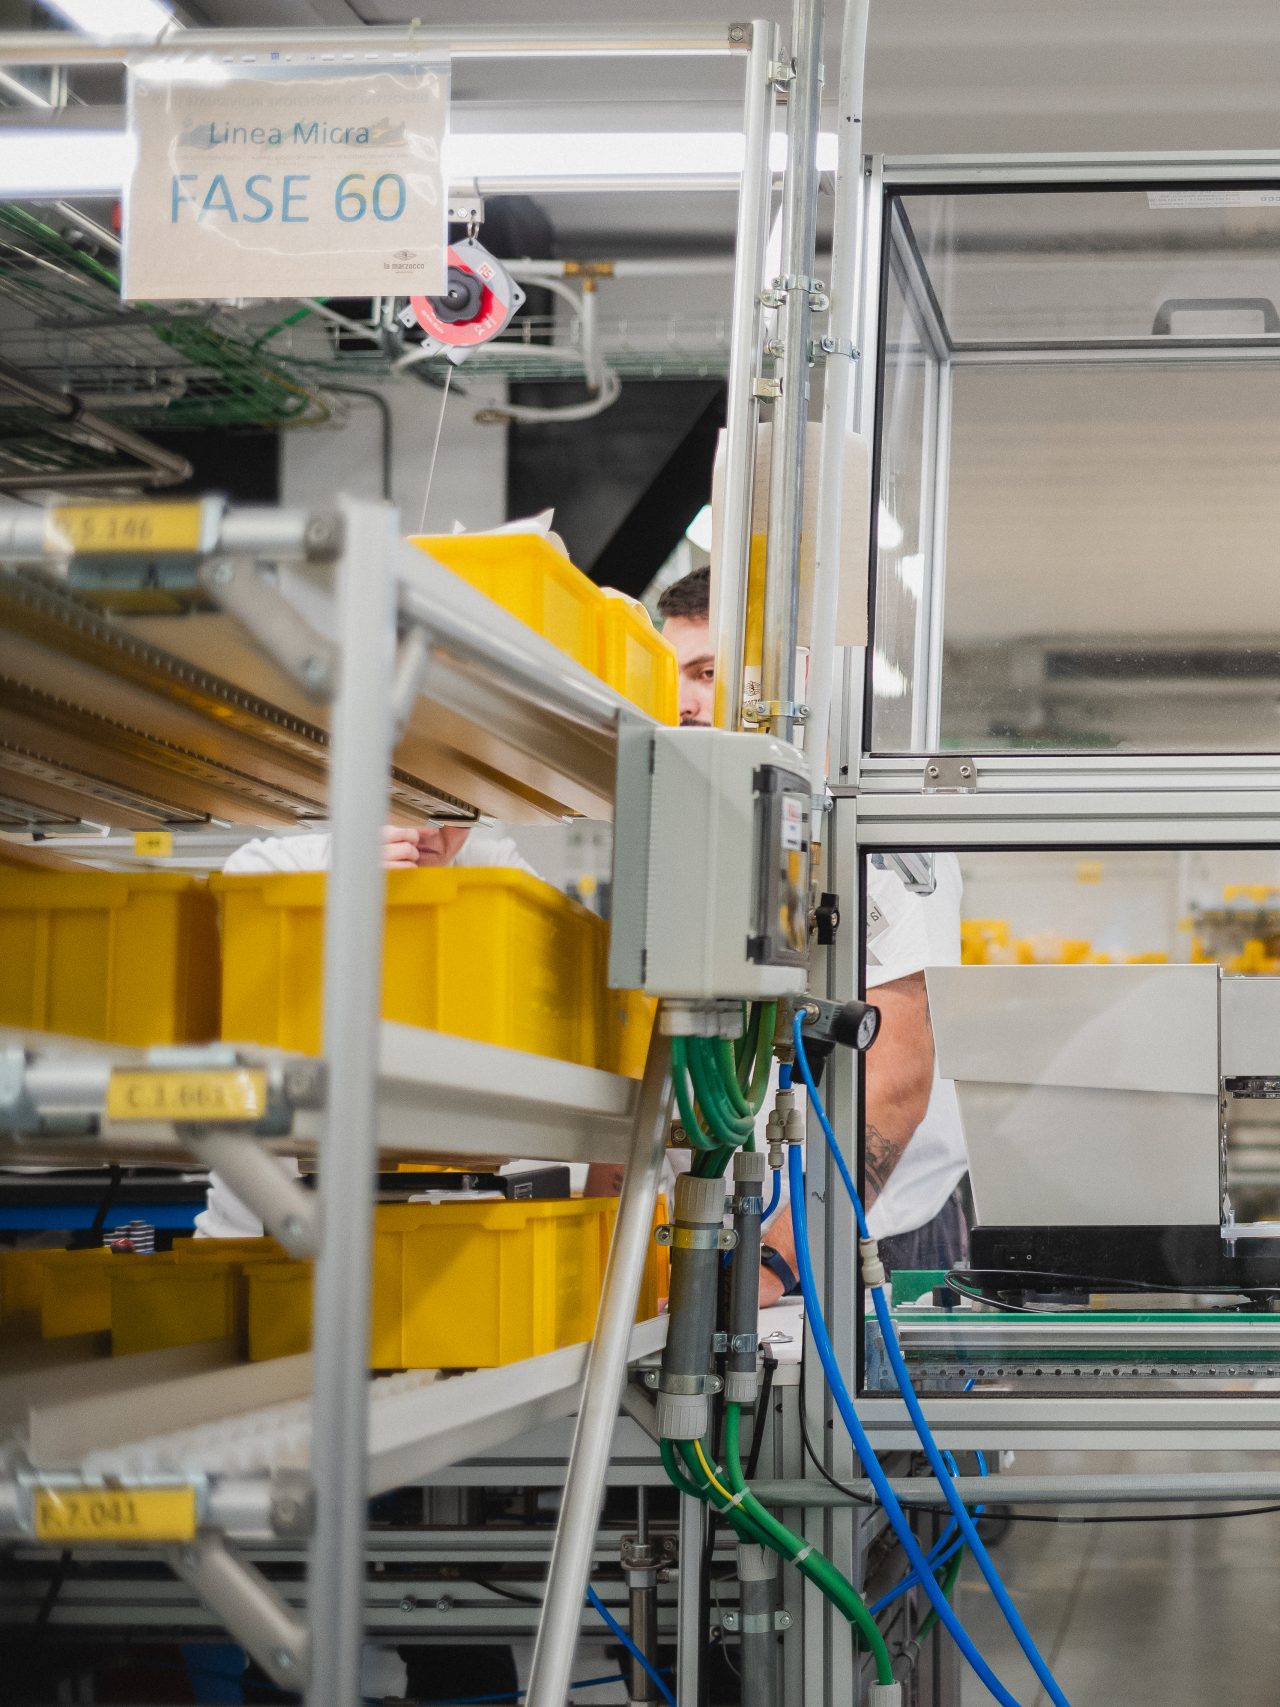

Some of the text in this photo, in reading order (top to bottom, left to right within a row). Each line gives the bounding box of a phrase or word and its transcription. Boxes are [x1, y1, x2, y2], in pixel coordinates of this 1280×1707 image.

[210, 121, 370, 145] Linea Micra
[171, 173, 407, 225] FASE 60
